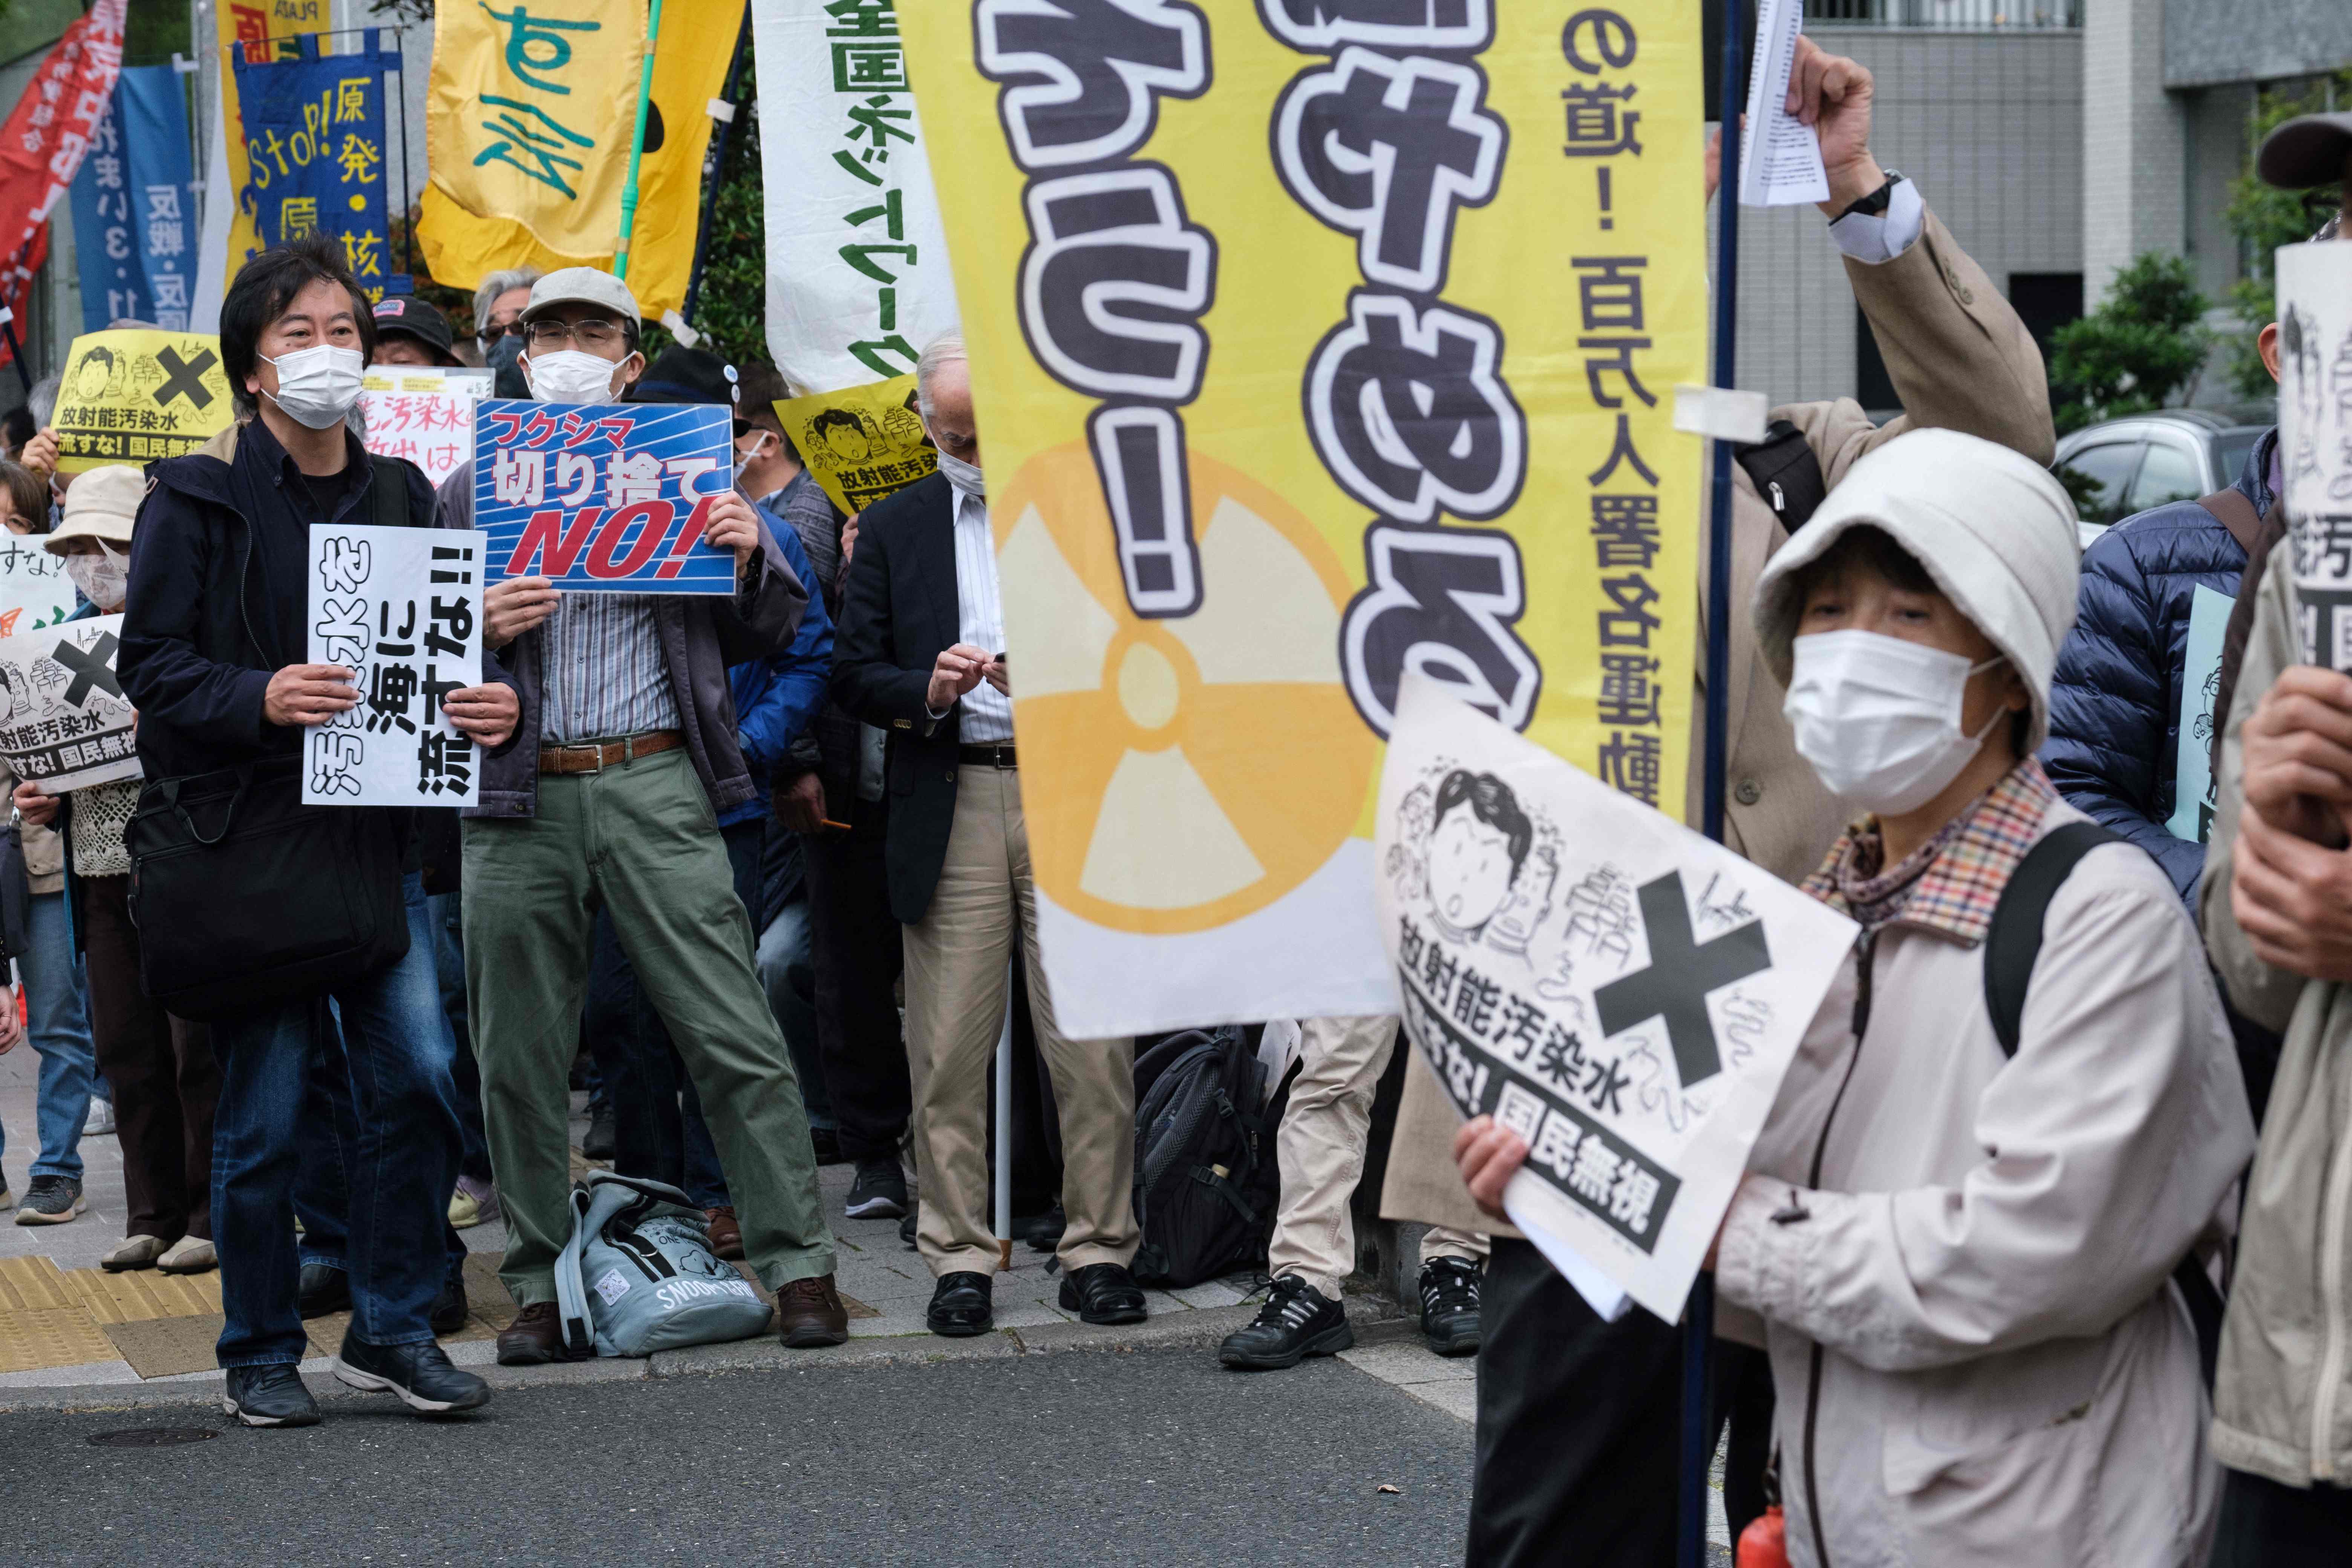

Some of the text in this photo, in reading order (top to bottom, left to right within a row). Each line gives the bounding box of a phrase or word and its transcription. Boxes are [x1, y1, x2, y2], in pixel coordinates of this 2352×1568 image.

[334, 77, 385, 304] 原発・核
[58, 433, 122, 455] 流すな!
[59, 406, 178, 431] 放射能汚染水
[491, 410, 636, 449] フクシマ
[492, 448, 717, 509] 切り捨て
[504, 495, 724, 579] NO!
[366, 600, 417, 735] 海に
[0, 709, 105, 750] 射能汚染水
[1400, 914, 1633, 1117] 放射能汚染水
[1494, 1079, 1661, 1236] 国民無視
